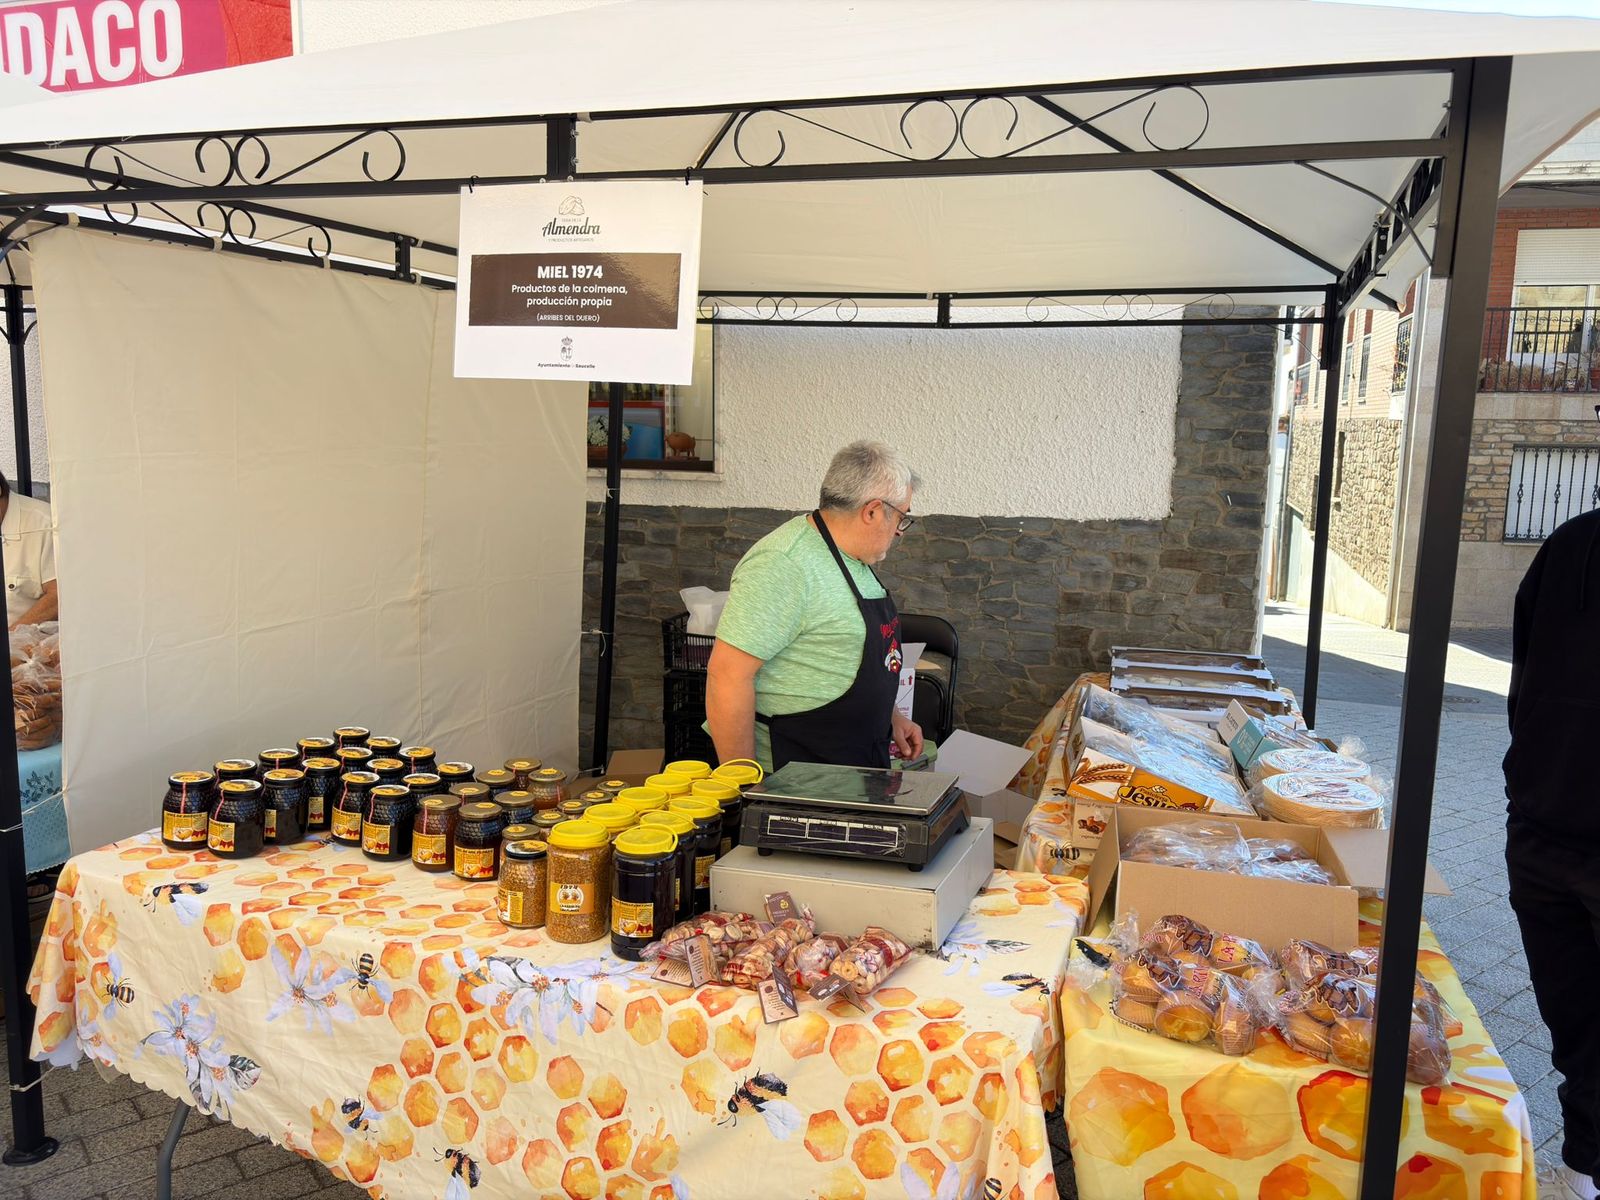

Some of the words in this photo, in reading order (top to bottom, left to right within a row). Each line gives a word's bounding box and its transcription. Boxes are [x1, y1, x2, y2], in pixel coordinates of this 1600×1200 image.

[0, 0, 183, 86] DACO
[542, 217, 601, 237] Almendra
[537, 266, 569, 279] MIEL
[571, 265, 603, 279] 1974
[511, 284, 557, 293] Productos
[558, 284, 570, 293] de
[572, 284, 581, 293] la
[583, 284, 628, 295] colmena,
[527, 296, 579, 308] producción
[580, 297, 612, 308] propia
[536, 313, 564, 321] (ARRIBES
[575, 314, 601, 323] DUERO)
